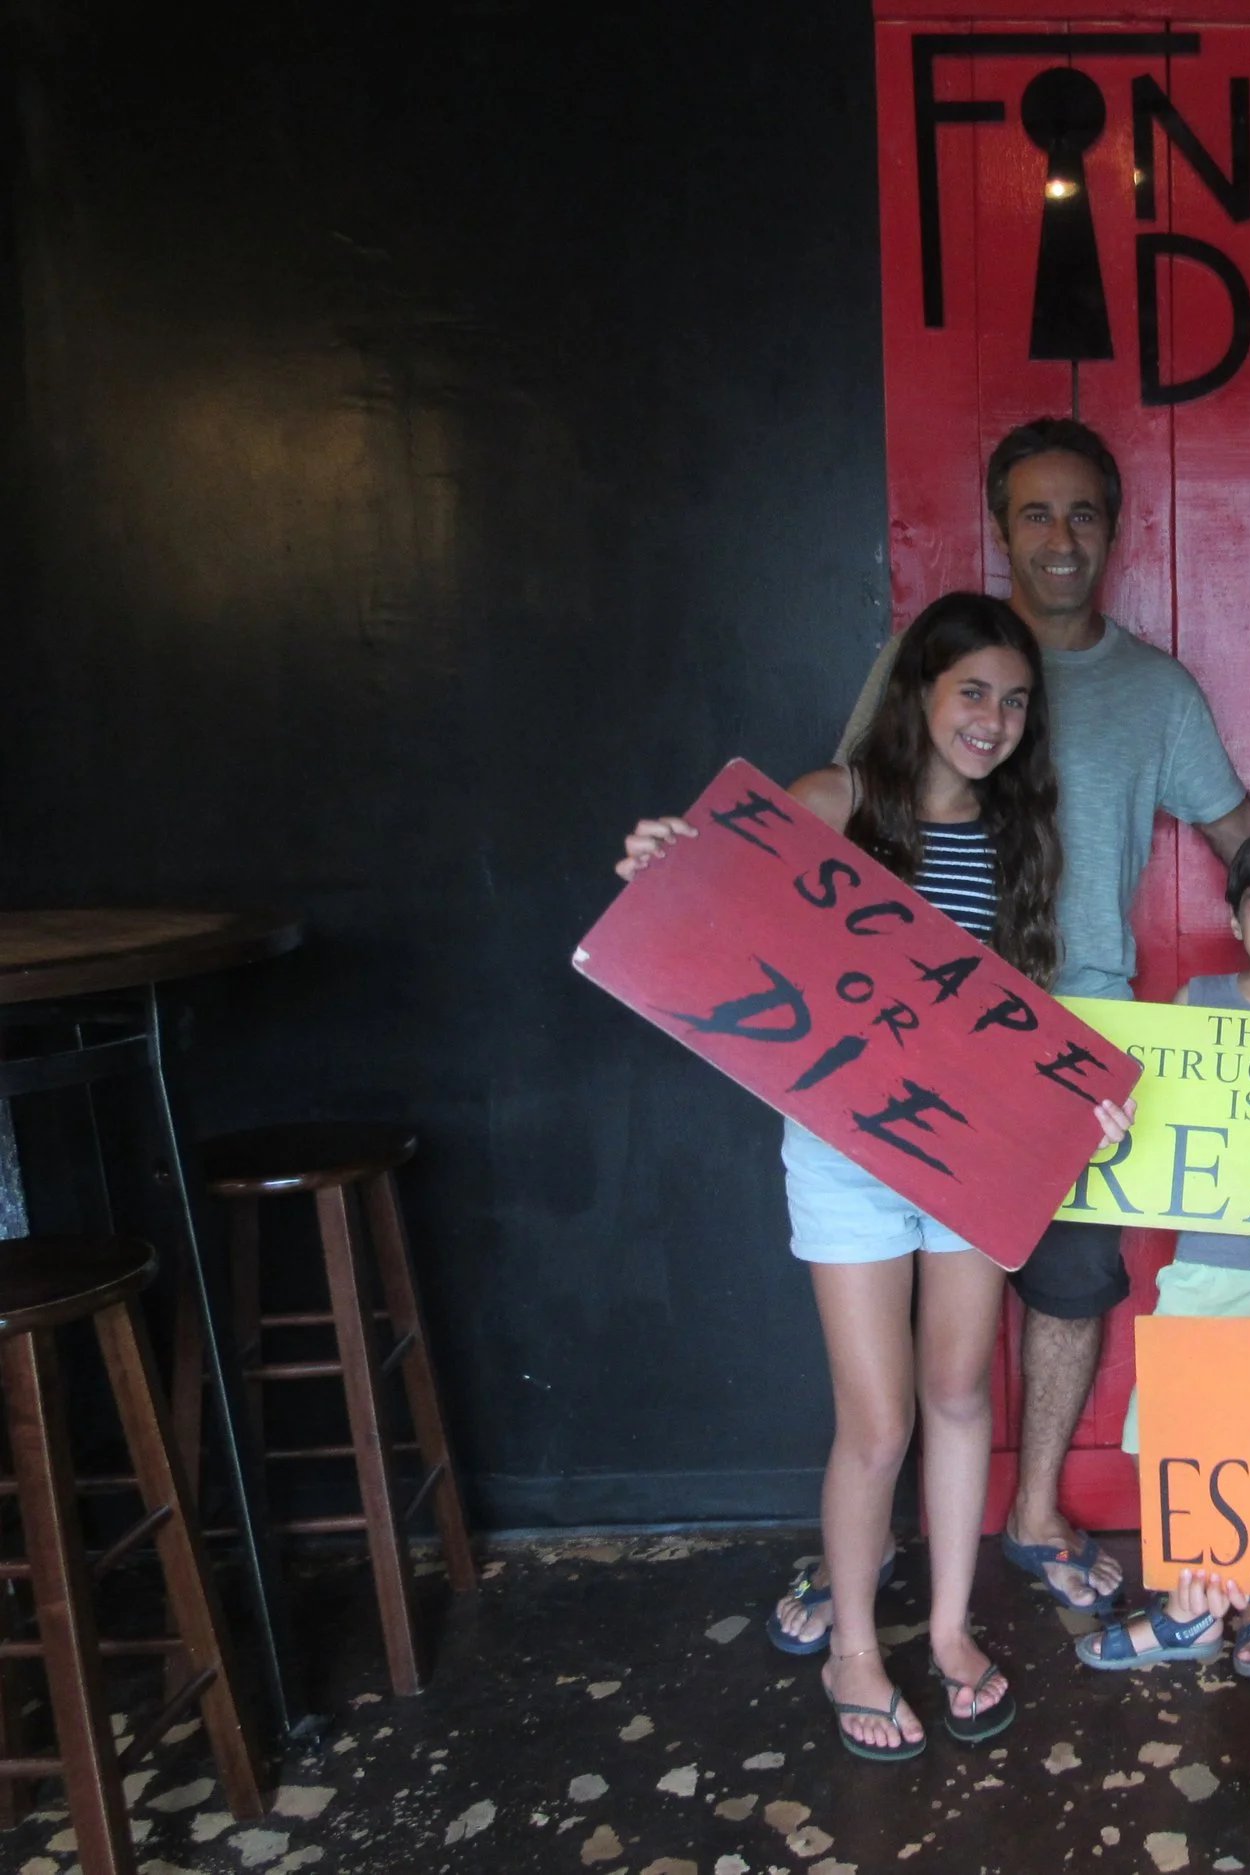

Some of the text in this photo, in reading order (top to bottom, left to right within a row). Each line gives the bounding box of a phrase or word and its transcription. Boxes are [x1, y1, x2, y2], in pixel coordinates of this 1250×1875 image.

[709, 789, 1111, 1105] ESCAPE
[835, 970, 921, 1046] OR
[648, 955, 976, 1184] DIE
